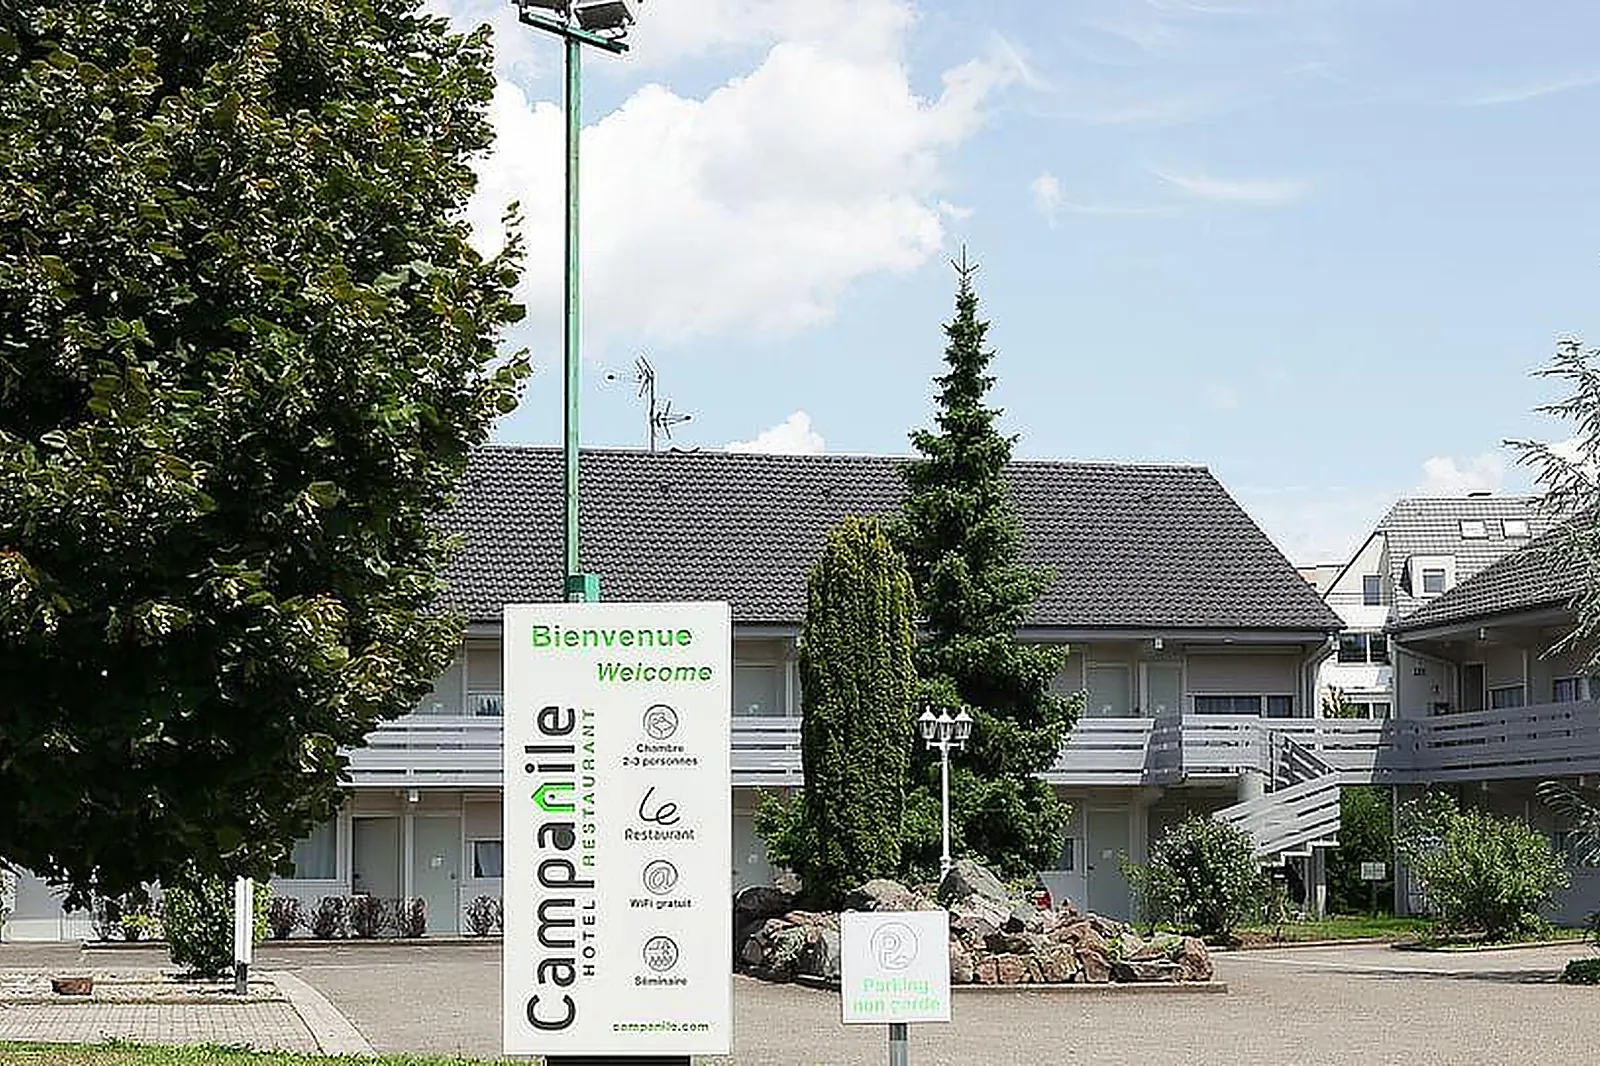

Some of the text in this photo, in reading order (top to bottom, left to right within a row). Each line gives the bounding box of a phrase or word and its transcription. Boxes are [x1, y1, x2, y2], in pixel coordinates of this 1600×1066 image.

[531, 625, 693, 648] Bienvenue
[597, 662, 713, 682] Welcome
[636, 743, 685, 753] Chambre
[642, 757, 699, 768] personnes
[624, 828, 696, 841] Restaurant
[582, 708, 597, 977] HOTEL RESTAURANT
[524, 706, 595, 1031] Campanile
[655, 898, 693, 909] gratuit
[863, 978, 929, 994] Parking
[854, 998, 885, 1012] non
[611, 1020, 709, 1032] campanile.com
